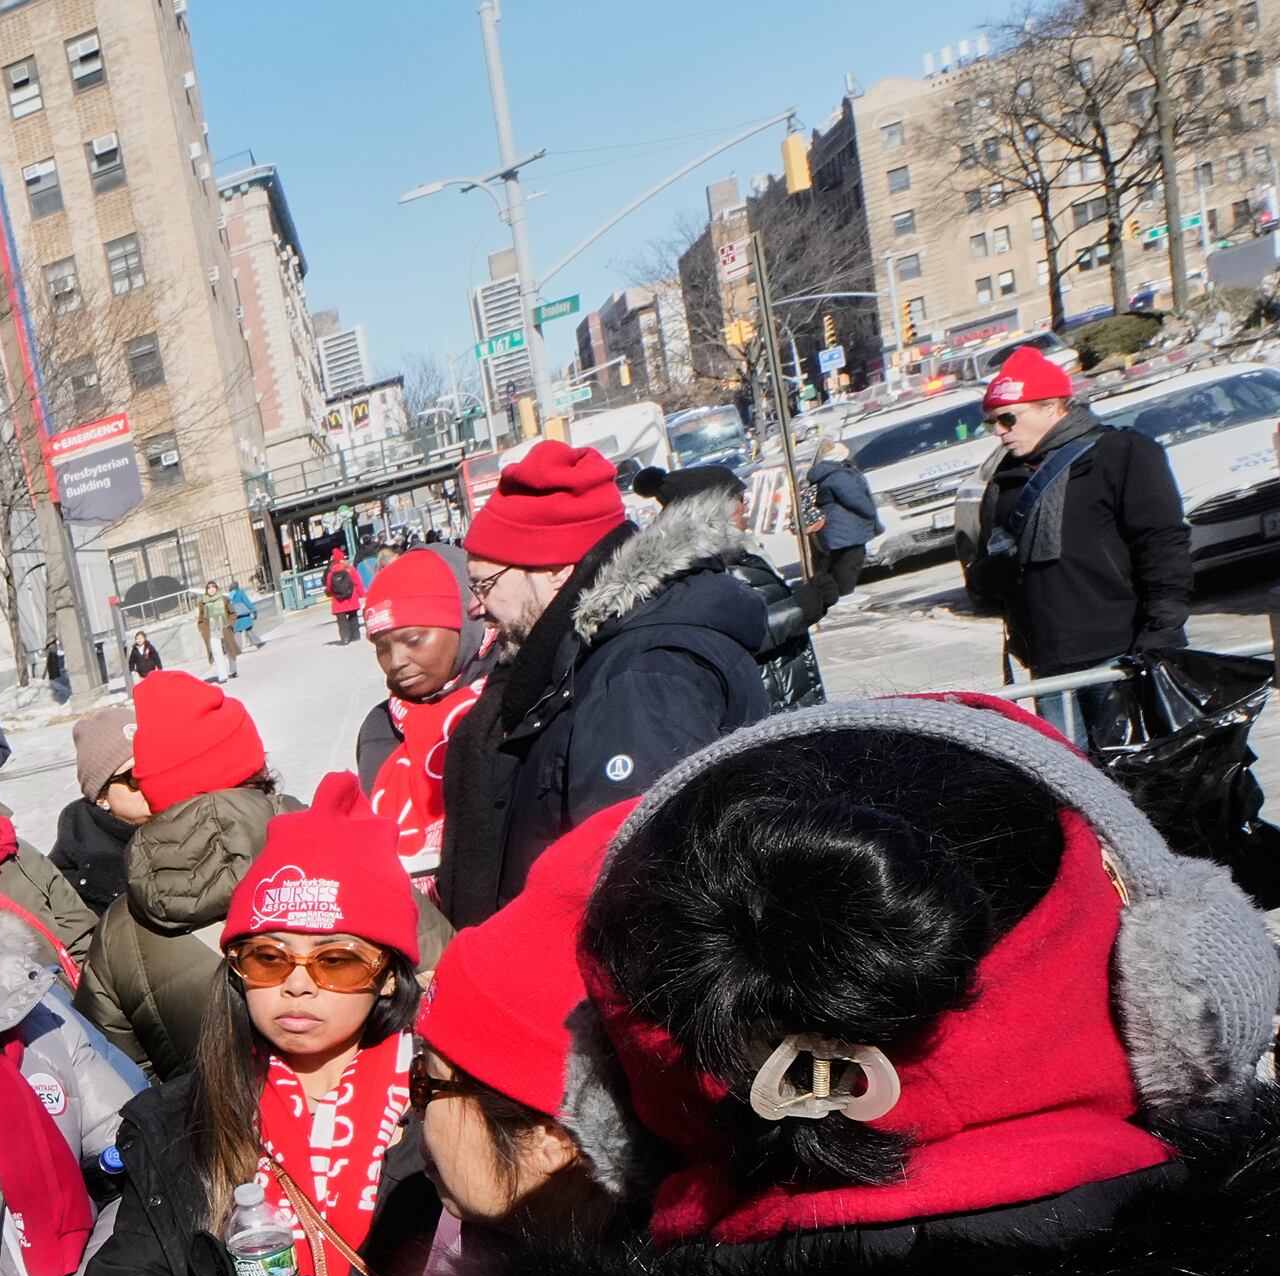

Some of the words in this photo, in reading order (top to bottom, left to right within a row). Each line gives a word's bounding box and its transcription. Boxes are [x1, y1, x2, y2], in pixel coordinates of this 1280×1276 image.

[541, 301, 571, 318] Broadway
[479, 344, 490, 357] W
[492, 336, 510, 354] 167
[61, 419, 125, 449] EMERGENCY
[63, 457, 129, 484] Presbyterian
[66, 477, 111, 498] Building
[283, 879, 300, 888] New
[300, 877, 318, 888] York
[318, 878, 339, 888] State
[264, 887, 338, 904] NURSES
[261, 901, 337, 913] ASSOCIATION
[32, 1084, 58, 1092] ONTRACT
